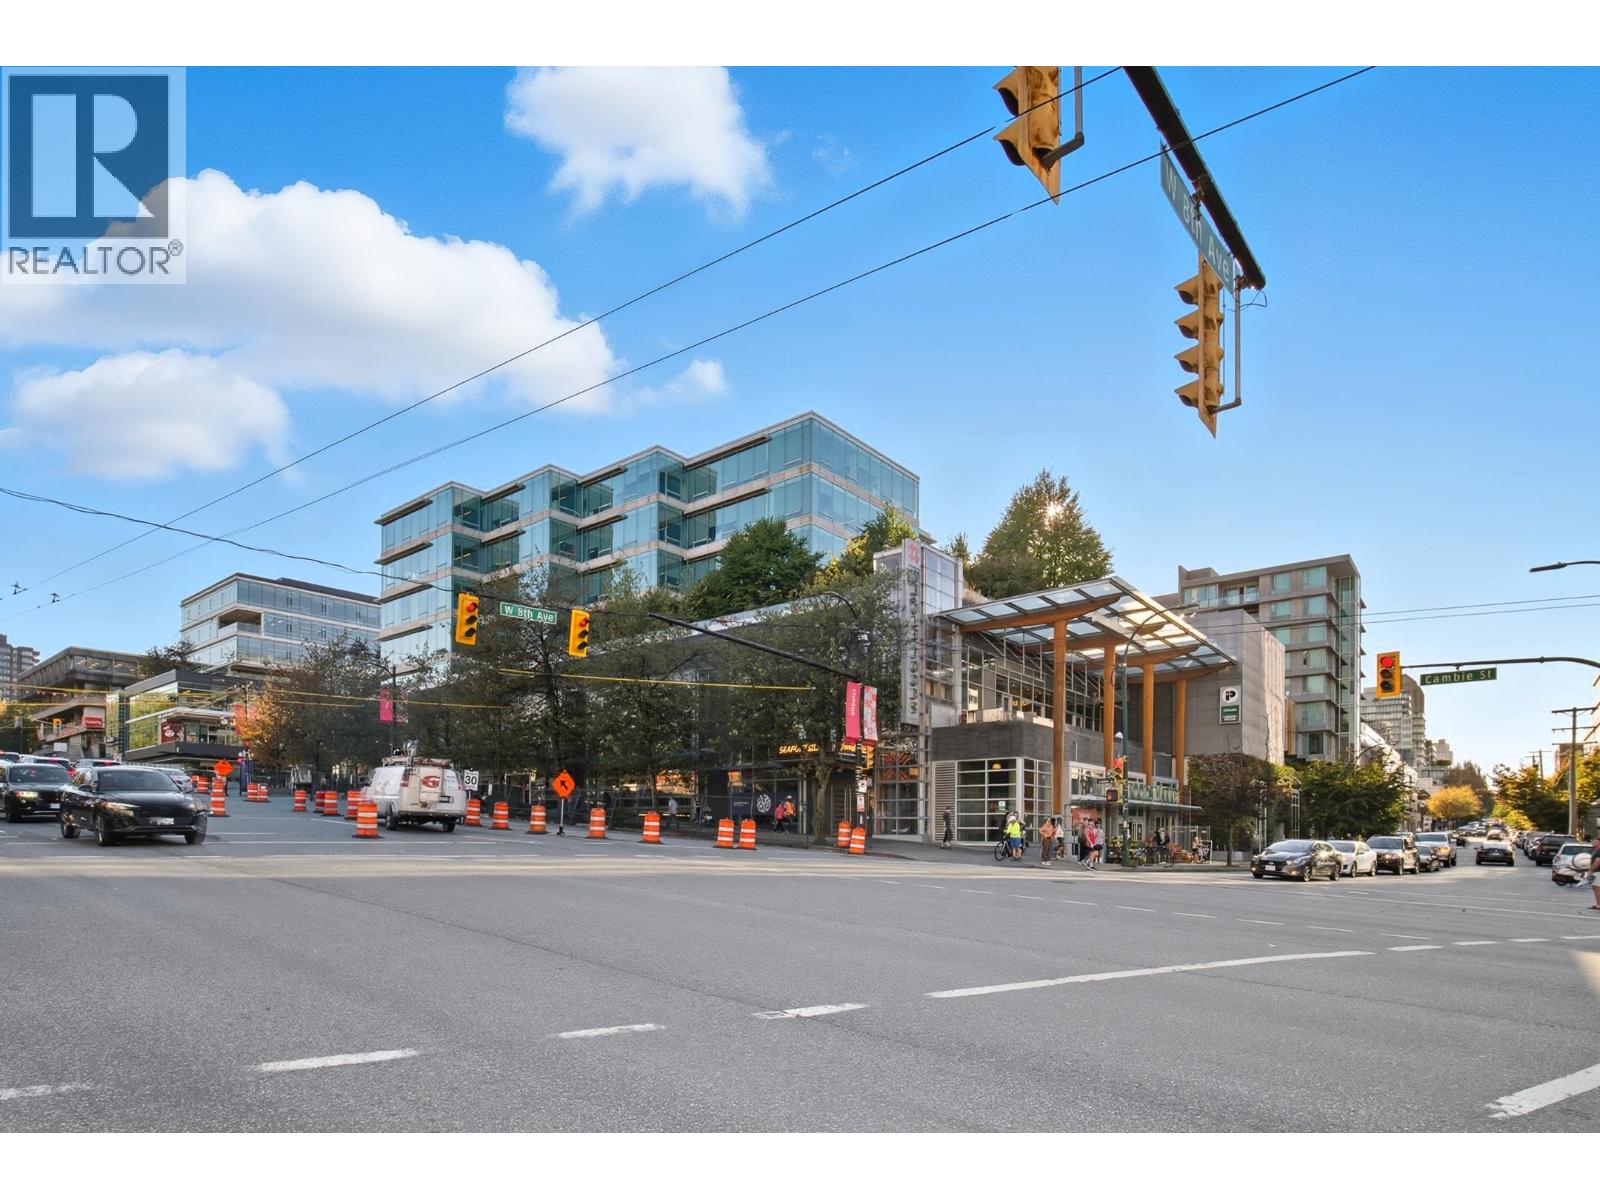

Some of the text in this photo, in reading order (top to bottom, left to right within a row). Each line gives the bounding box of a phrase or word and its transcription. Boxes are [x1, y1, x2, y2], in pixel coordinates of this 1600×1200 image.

[1164, 159, 1231, 283] W 8th Ave
[504, 605, 554, 622] W 8th Ave
[1425, 670, 1491, 684] Cambie St
[465, 775, 477, 785] 30
